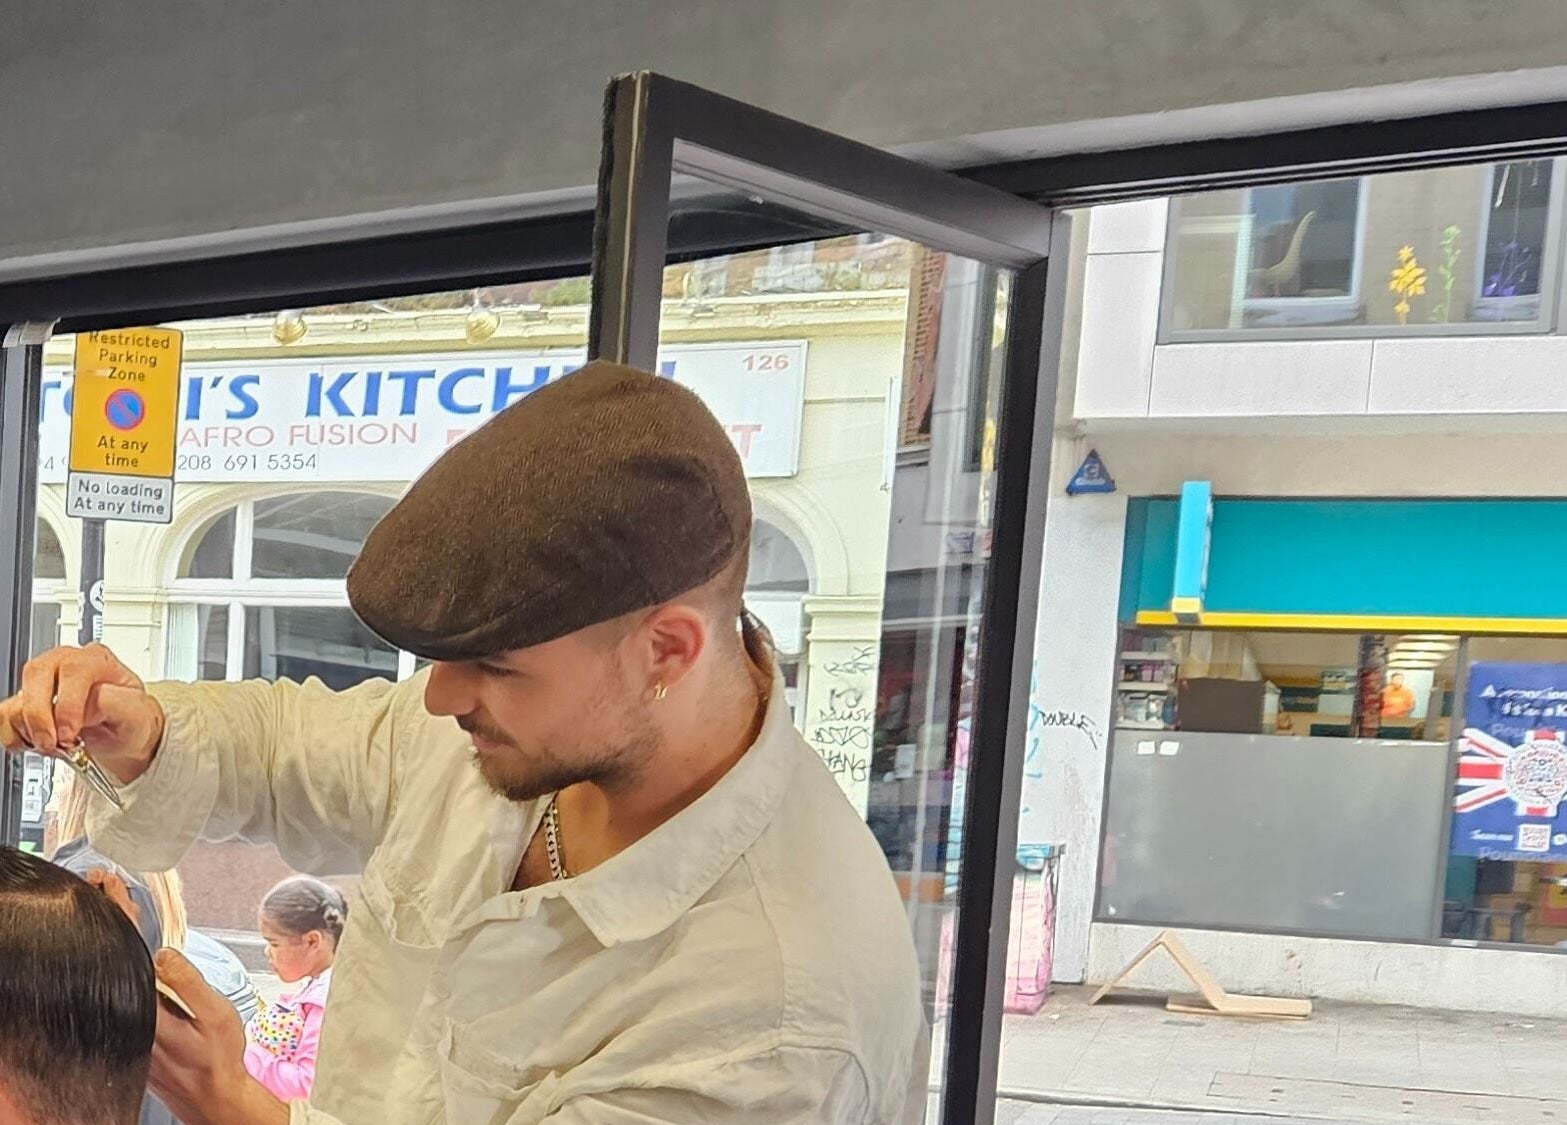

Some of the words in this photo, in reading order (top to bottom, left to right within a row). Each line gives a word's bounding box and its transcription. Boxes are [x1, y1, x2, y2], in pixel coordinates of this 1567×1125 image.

[89, 331, 170, 349] Restricted
[99, 349, 157, 368] Parking
[743, 355, 789, 371] 126
[108, 367, 145, 381] Zone
[306, 361, 676, 418] KITCH
[180, 425, 274, 447] AFRO
[289, 422, 416, 446] FUSION
[98, 436, 115, 448] At
[121, 438, 149, 453] any
[105, 454, 139, 468] time
[224, 454, 256, 470] 691
[268, 453, 317, 469] 5354
[78, 479, 100, 494] No
[106, 480, 163, 500] loading
[74, 497, 92, 510] At
[98, 500, 125, 514] any
[131, 498, 165, 515] time
